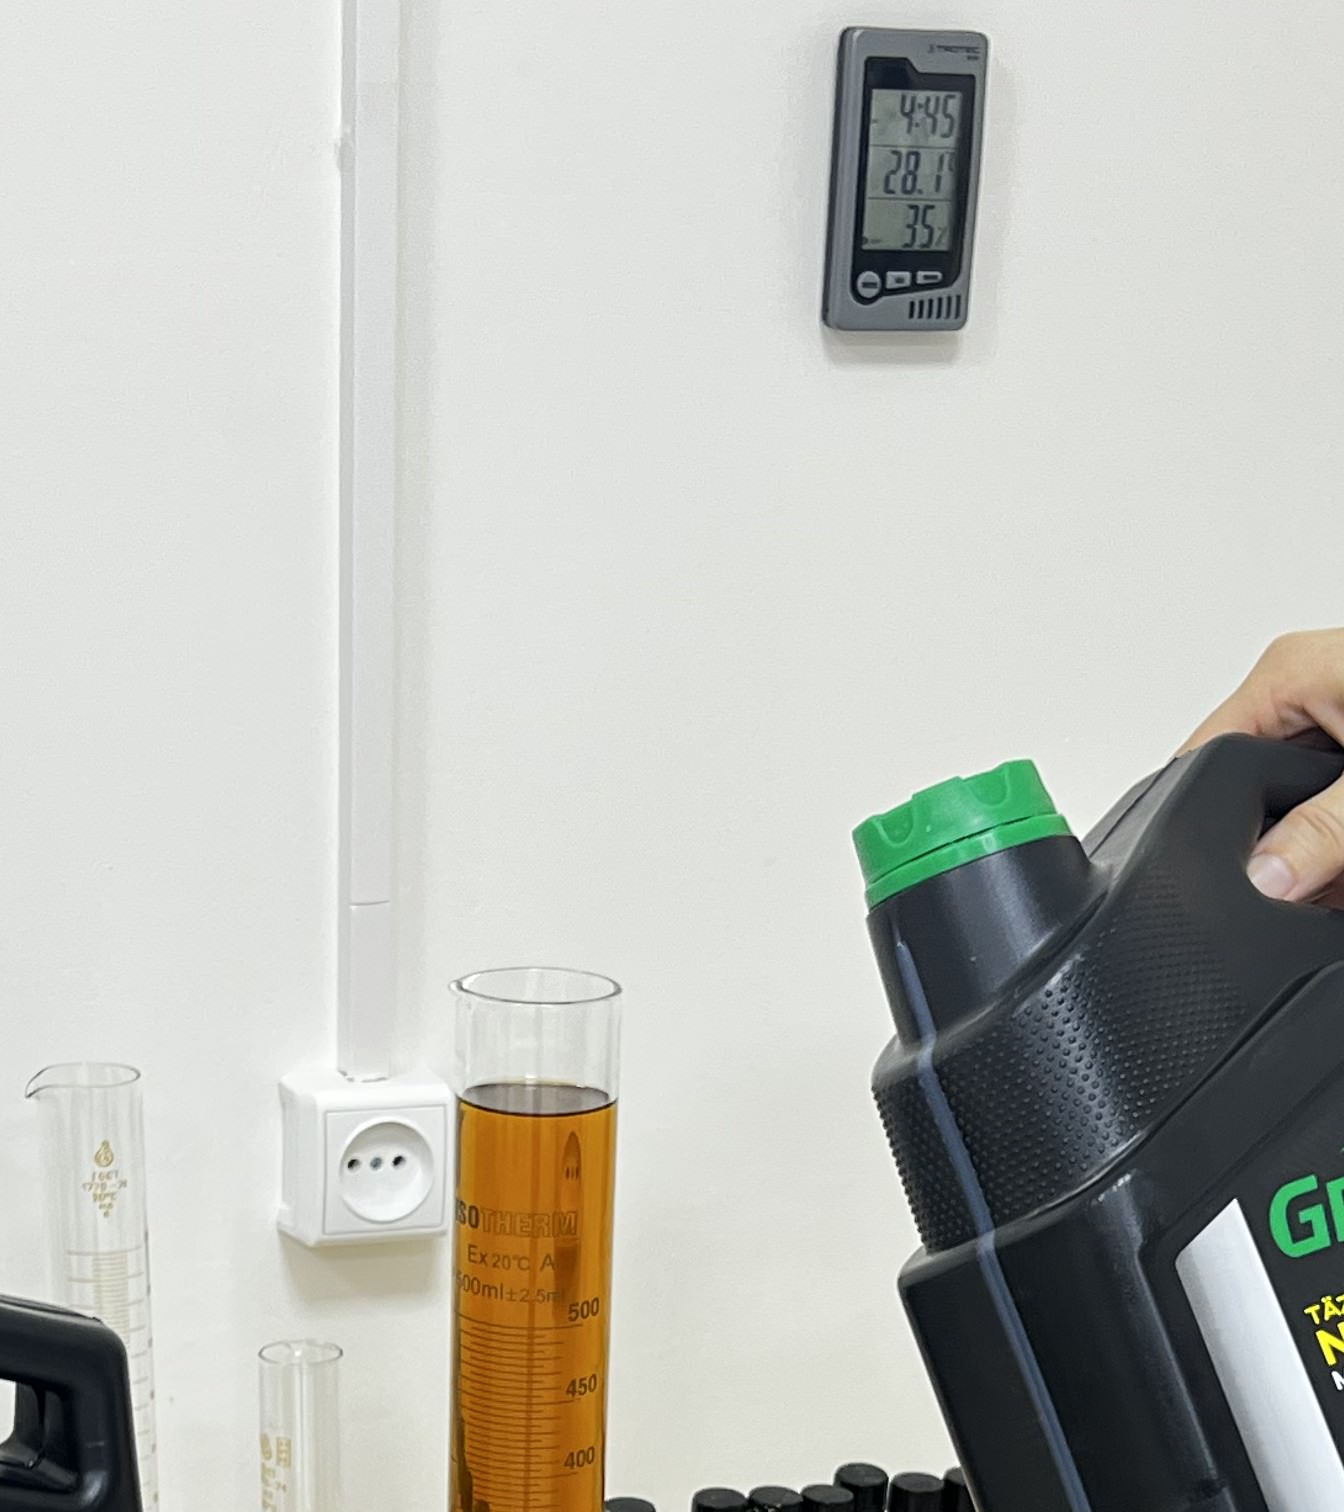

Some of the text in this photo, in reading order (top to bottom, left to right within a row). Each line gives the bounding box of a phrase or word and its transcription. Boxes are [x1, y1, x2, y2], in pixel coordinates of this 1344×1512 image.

[900, 94, 956, 139] 4:45
[468, 1244, 487, 1267] Ex
[492, 1252, 531, 1272] 20°C
[568, 1297, 599, 1322] 500
[565, 1373, 597, 1398] 450
[564, 1446, 595, 1470] 400
